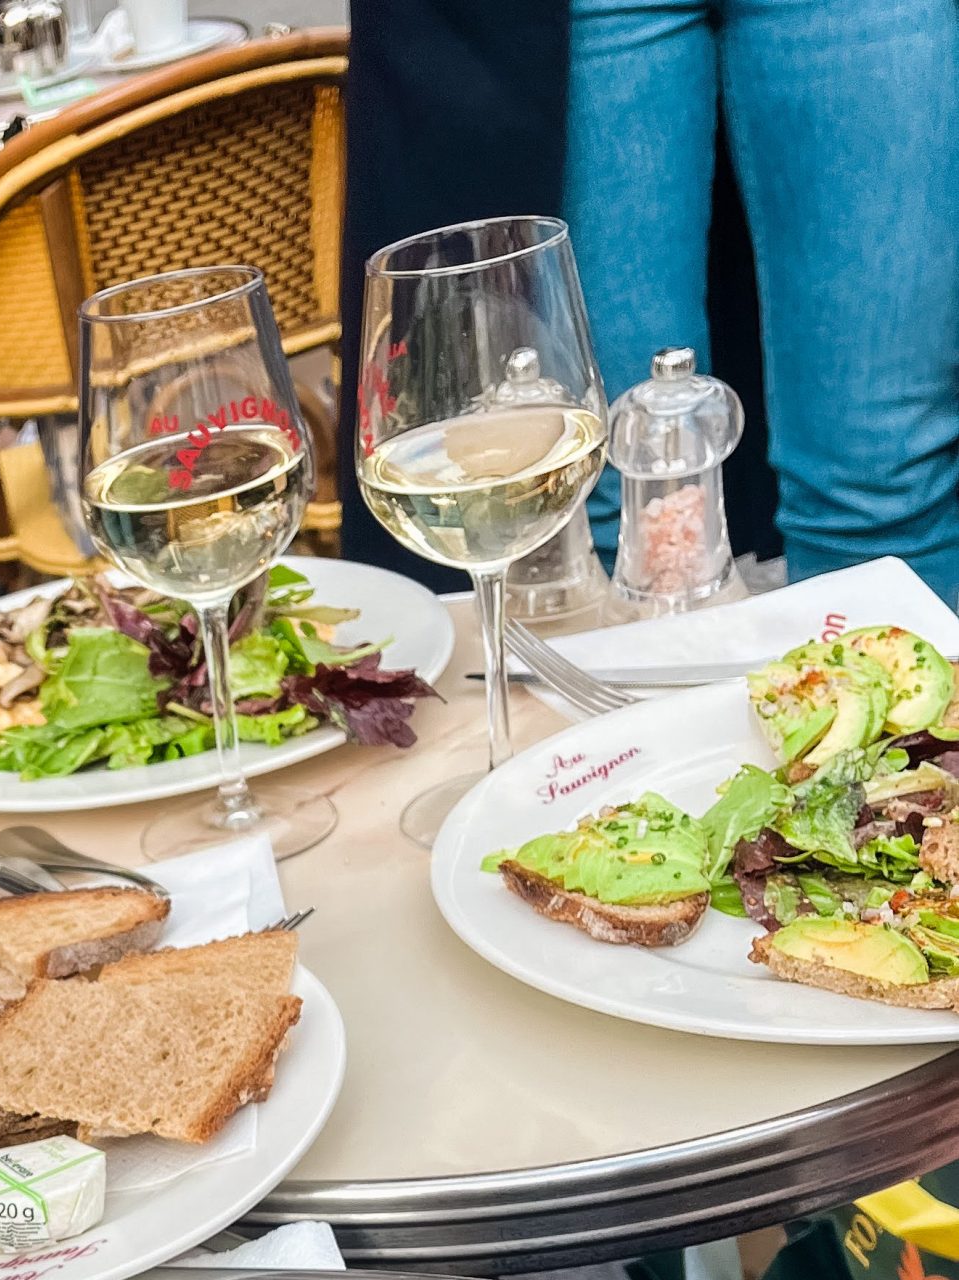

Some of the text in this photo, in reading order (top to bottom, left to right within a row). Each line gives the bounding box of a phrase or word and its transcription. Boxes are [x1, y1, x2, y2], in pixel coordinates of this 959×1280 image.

[150, 415, 179, 433] AU
[168, 396, 302, 490] SAUVIGNON
[536, 746, 642, 804] Sauvignon
[546, 753, 586, 778] Au
[22, 1207, 34, 1222] g
